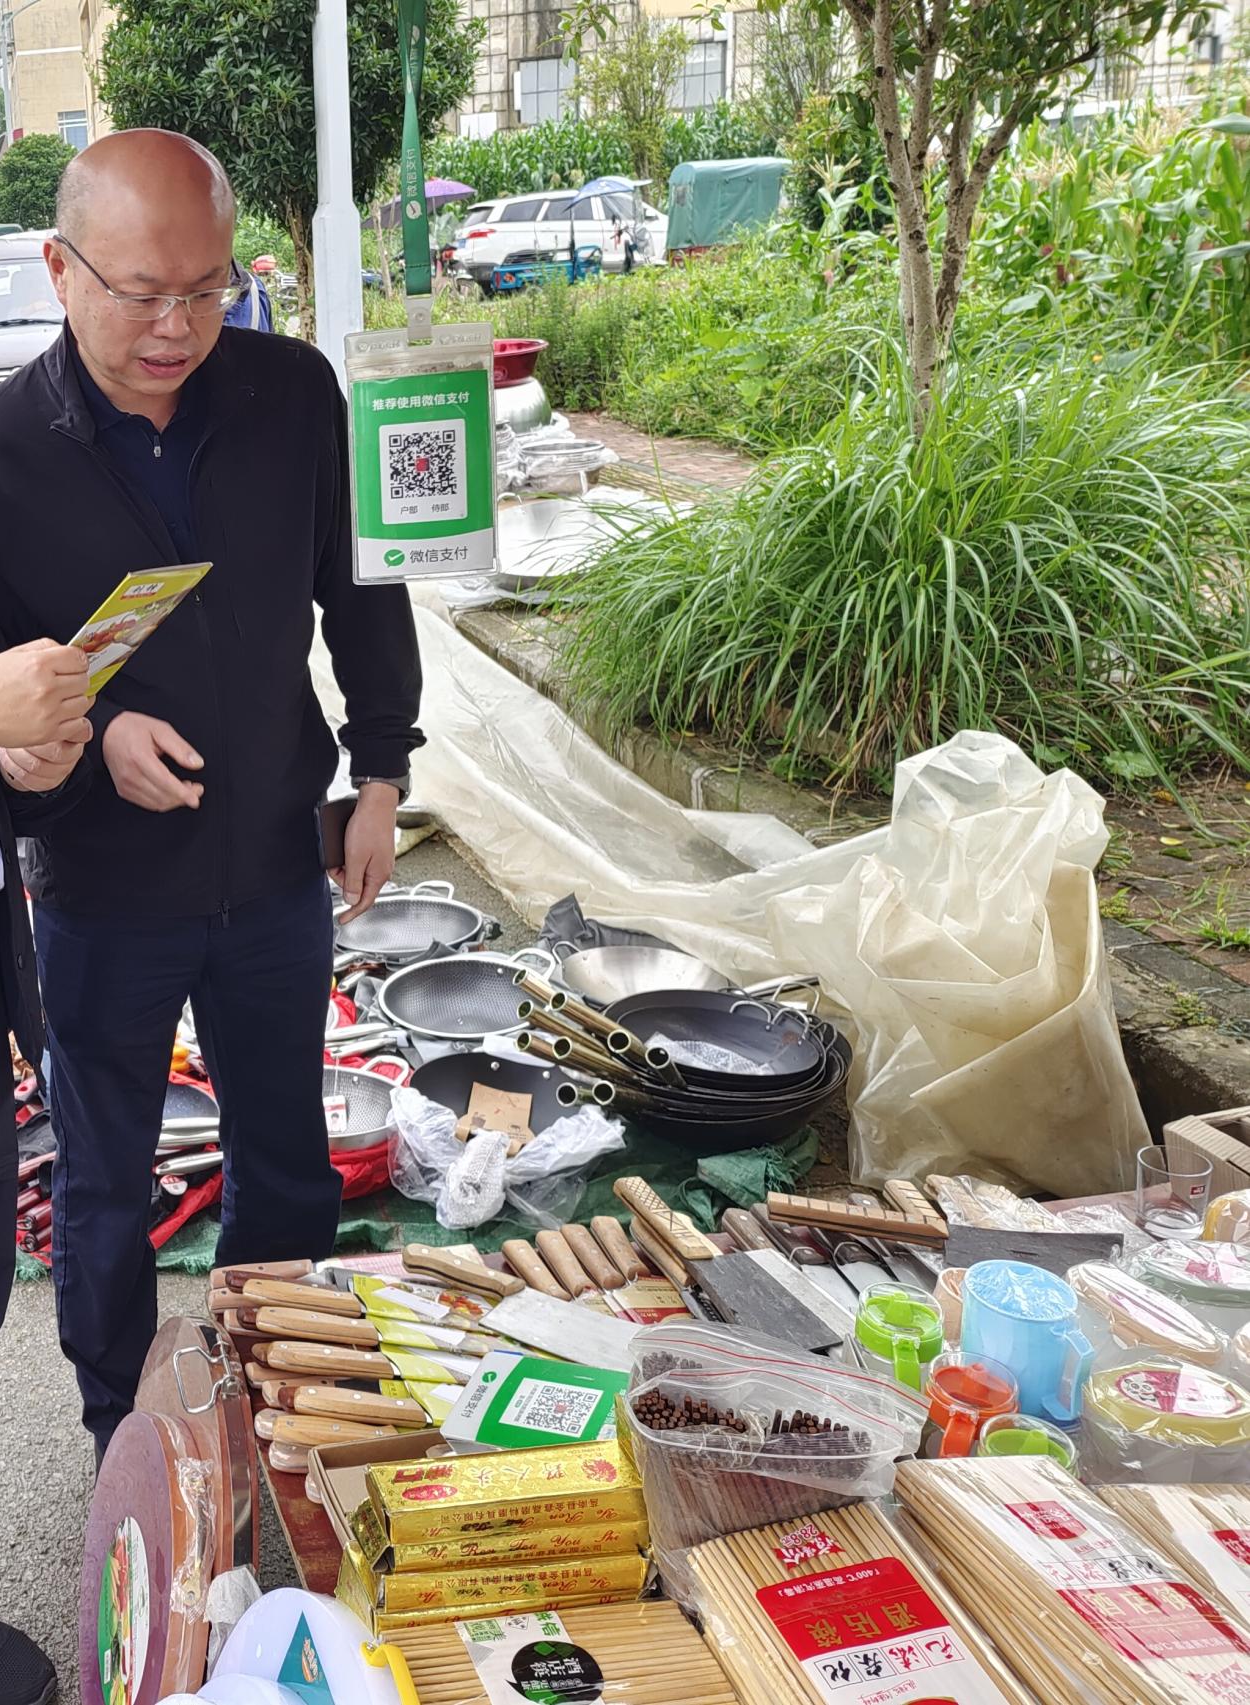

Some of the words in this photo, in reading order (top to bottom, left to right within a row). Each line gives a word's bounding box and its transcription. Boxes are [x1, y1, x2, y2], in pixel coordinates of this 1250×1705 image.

[372, 391, 470, 411] 推荐使用微信支付
[409, 547, 469, 564] 微信支付
[460, 1383, 489, 1417] 微信支付
[804, 1601, 922, 1648] 酒店筷
[530, 1657, 584, 1678] 酒店筷
